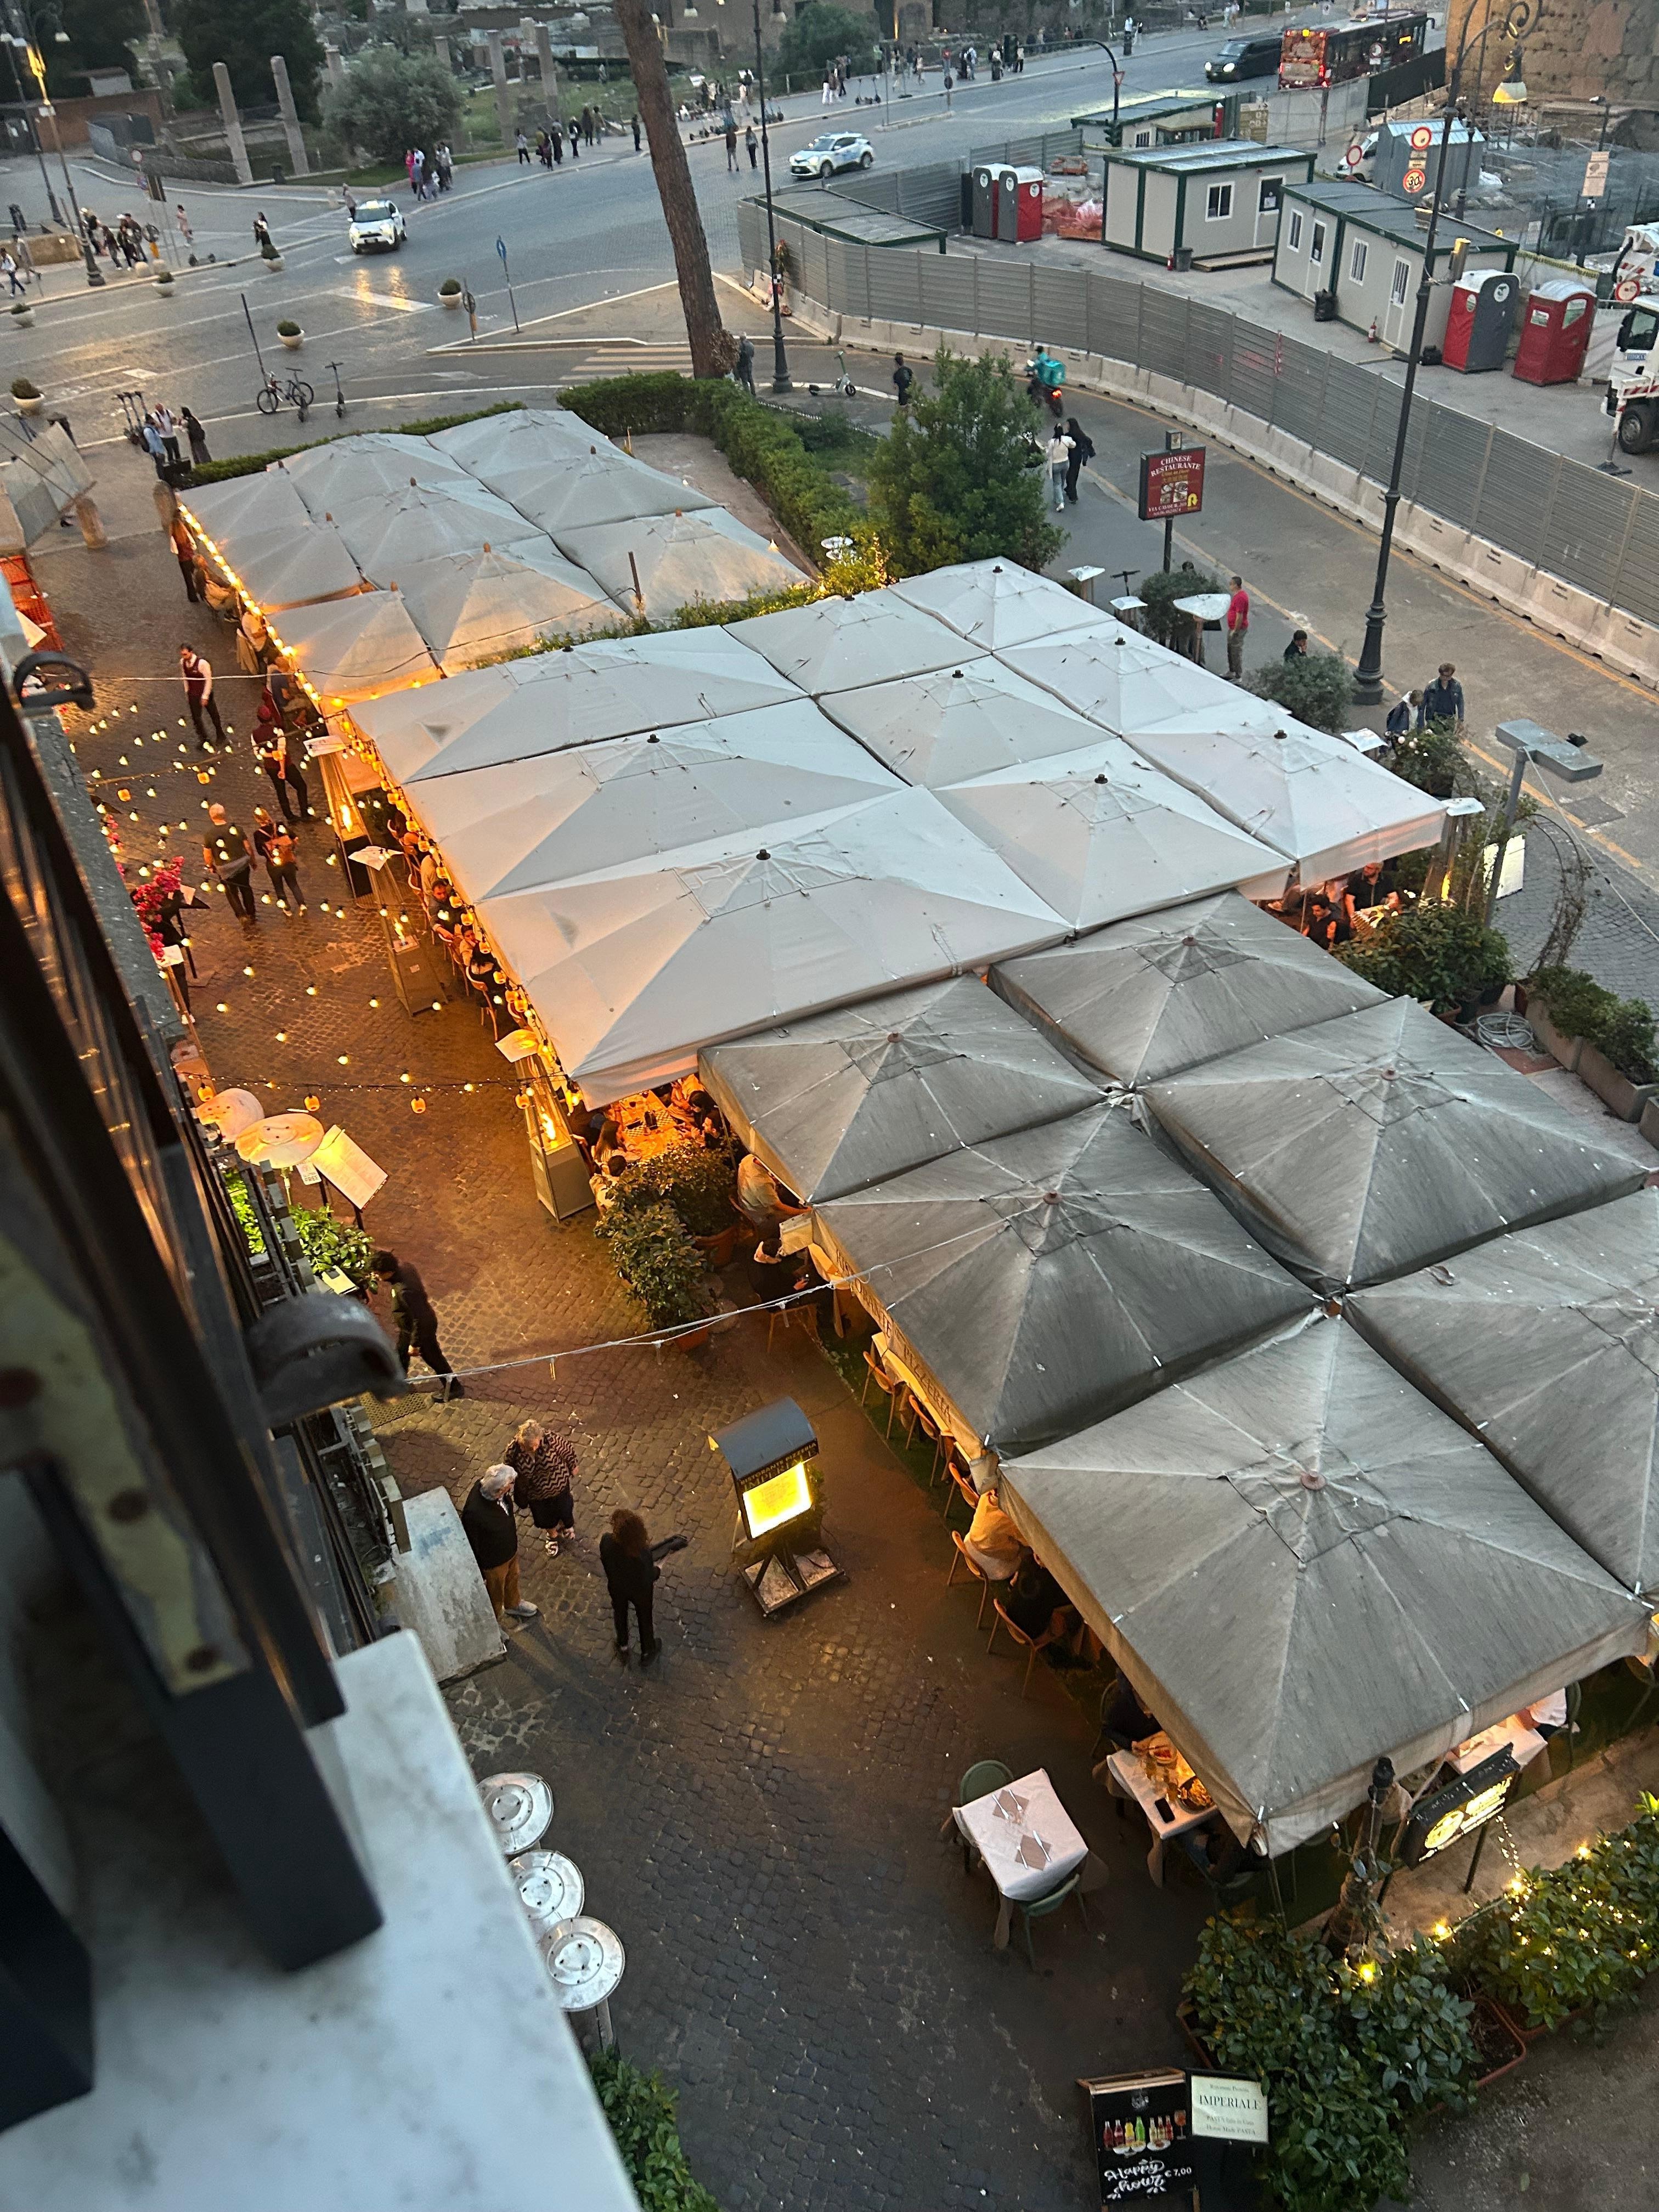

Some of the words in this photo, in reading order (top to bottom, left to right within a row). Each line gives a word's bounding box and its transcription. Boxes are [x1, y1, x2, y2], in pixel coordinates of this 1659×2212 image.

[1408, 176, 1420, 186] 30
[1160, 455, 1192, 465] CHINESE
[1150, 462, 1201, 477] RESTAURANTE
[836, 1249, 893, 1338] RISORANTE
[904, 1344, 951, 1424] PIZZERIA
[741, 1460, 783, 1485] RISTORANTE
[786, 1442, 816, 1462] PIZZERIA
[1200, 2095, 1261, 2111] IMPERIALE
